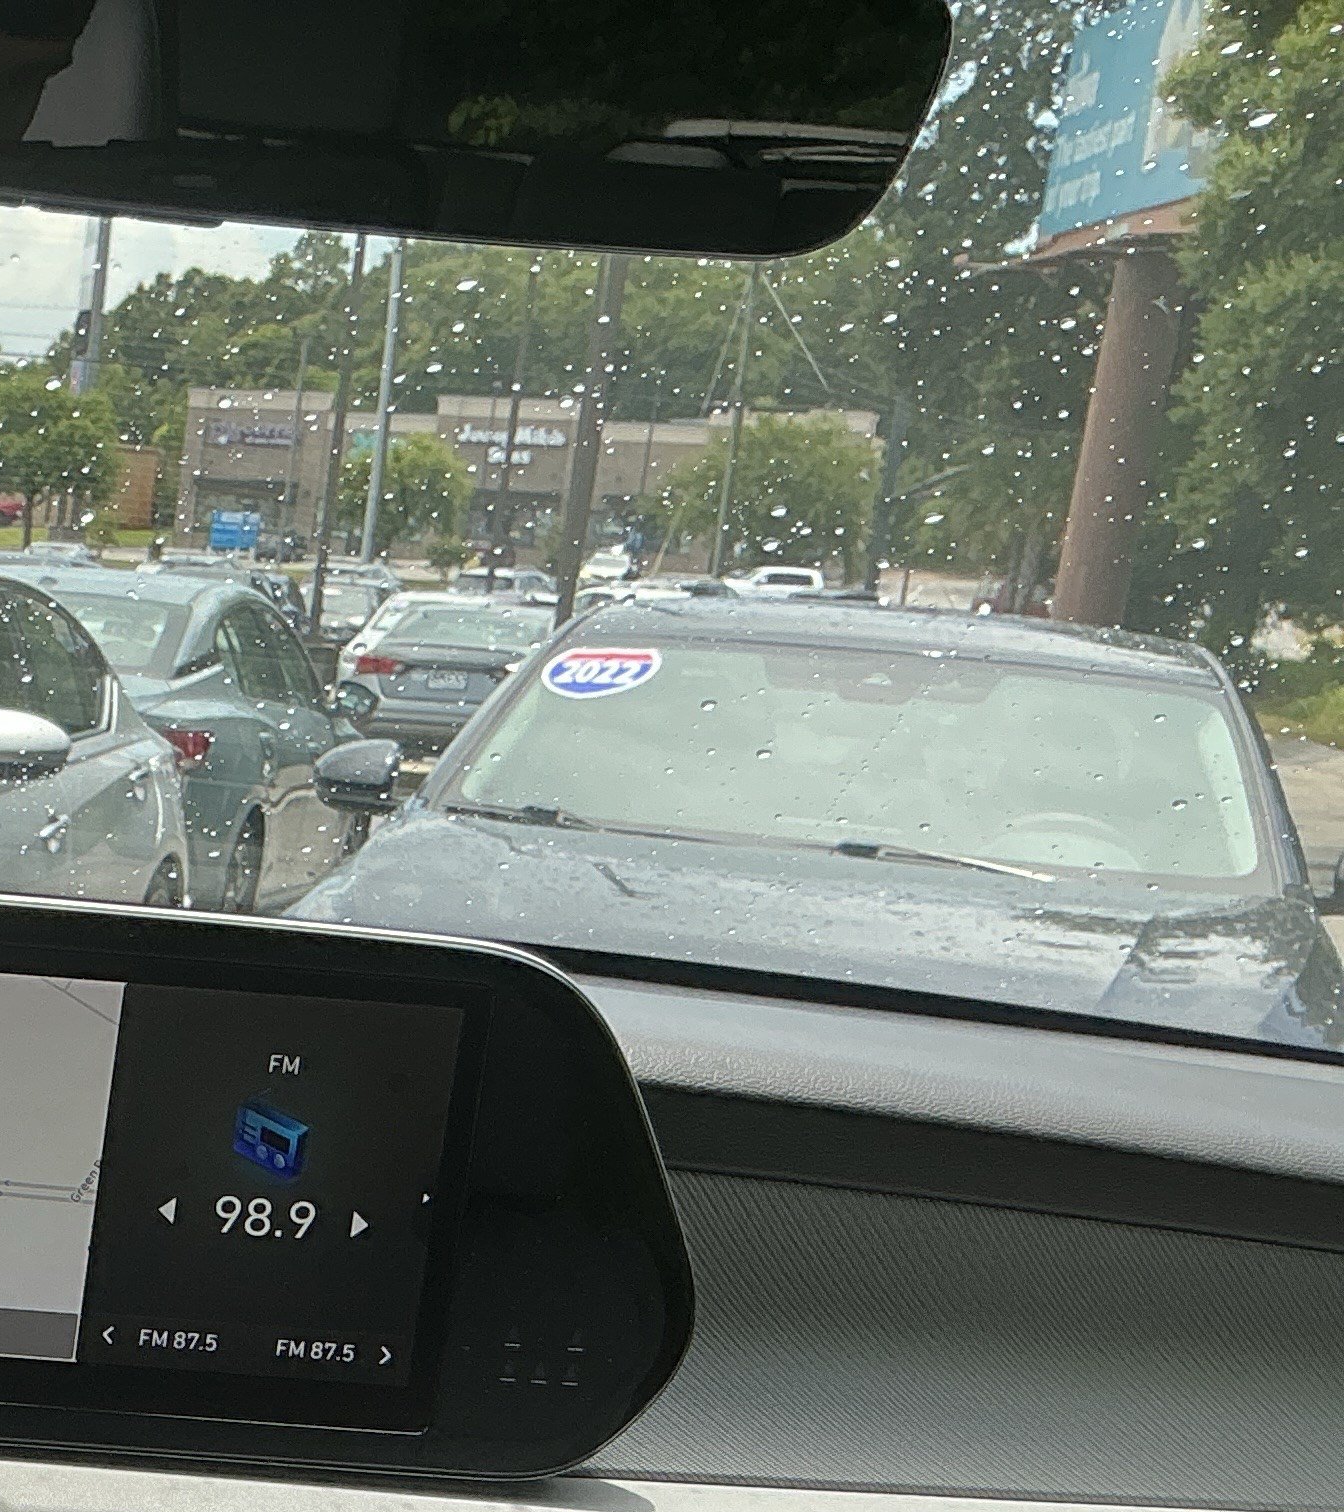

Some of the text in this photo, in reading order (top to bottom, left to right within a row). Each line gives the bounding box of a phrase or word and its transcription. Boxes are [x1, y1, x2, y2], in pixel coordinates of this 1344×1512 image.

[551, 660, 642, 684] 2022
[268, 1054, 301, 1076] FM
[71, 1169, 98, 1203] Green
[214, 1195, 317, 1239] 98.9
[138, 1328, 219, 1352] FM 87.5
[275, 1338, 356, 1363] FM 87.5
